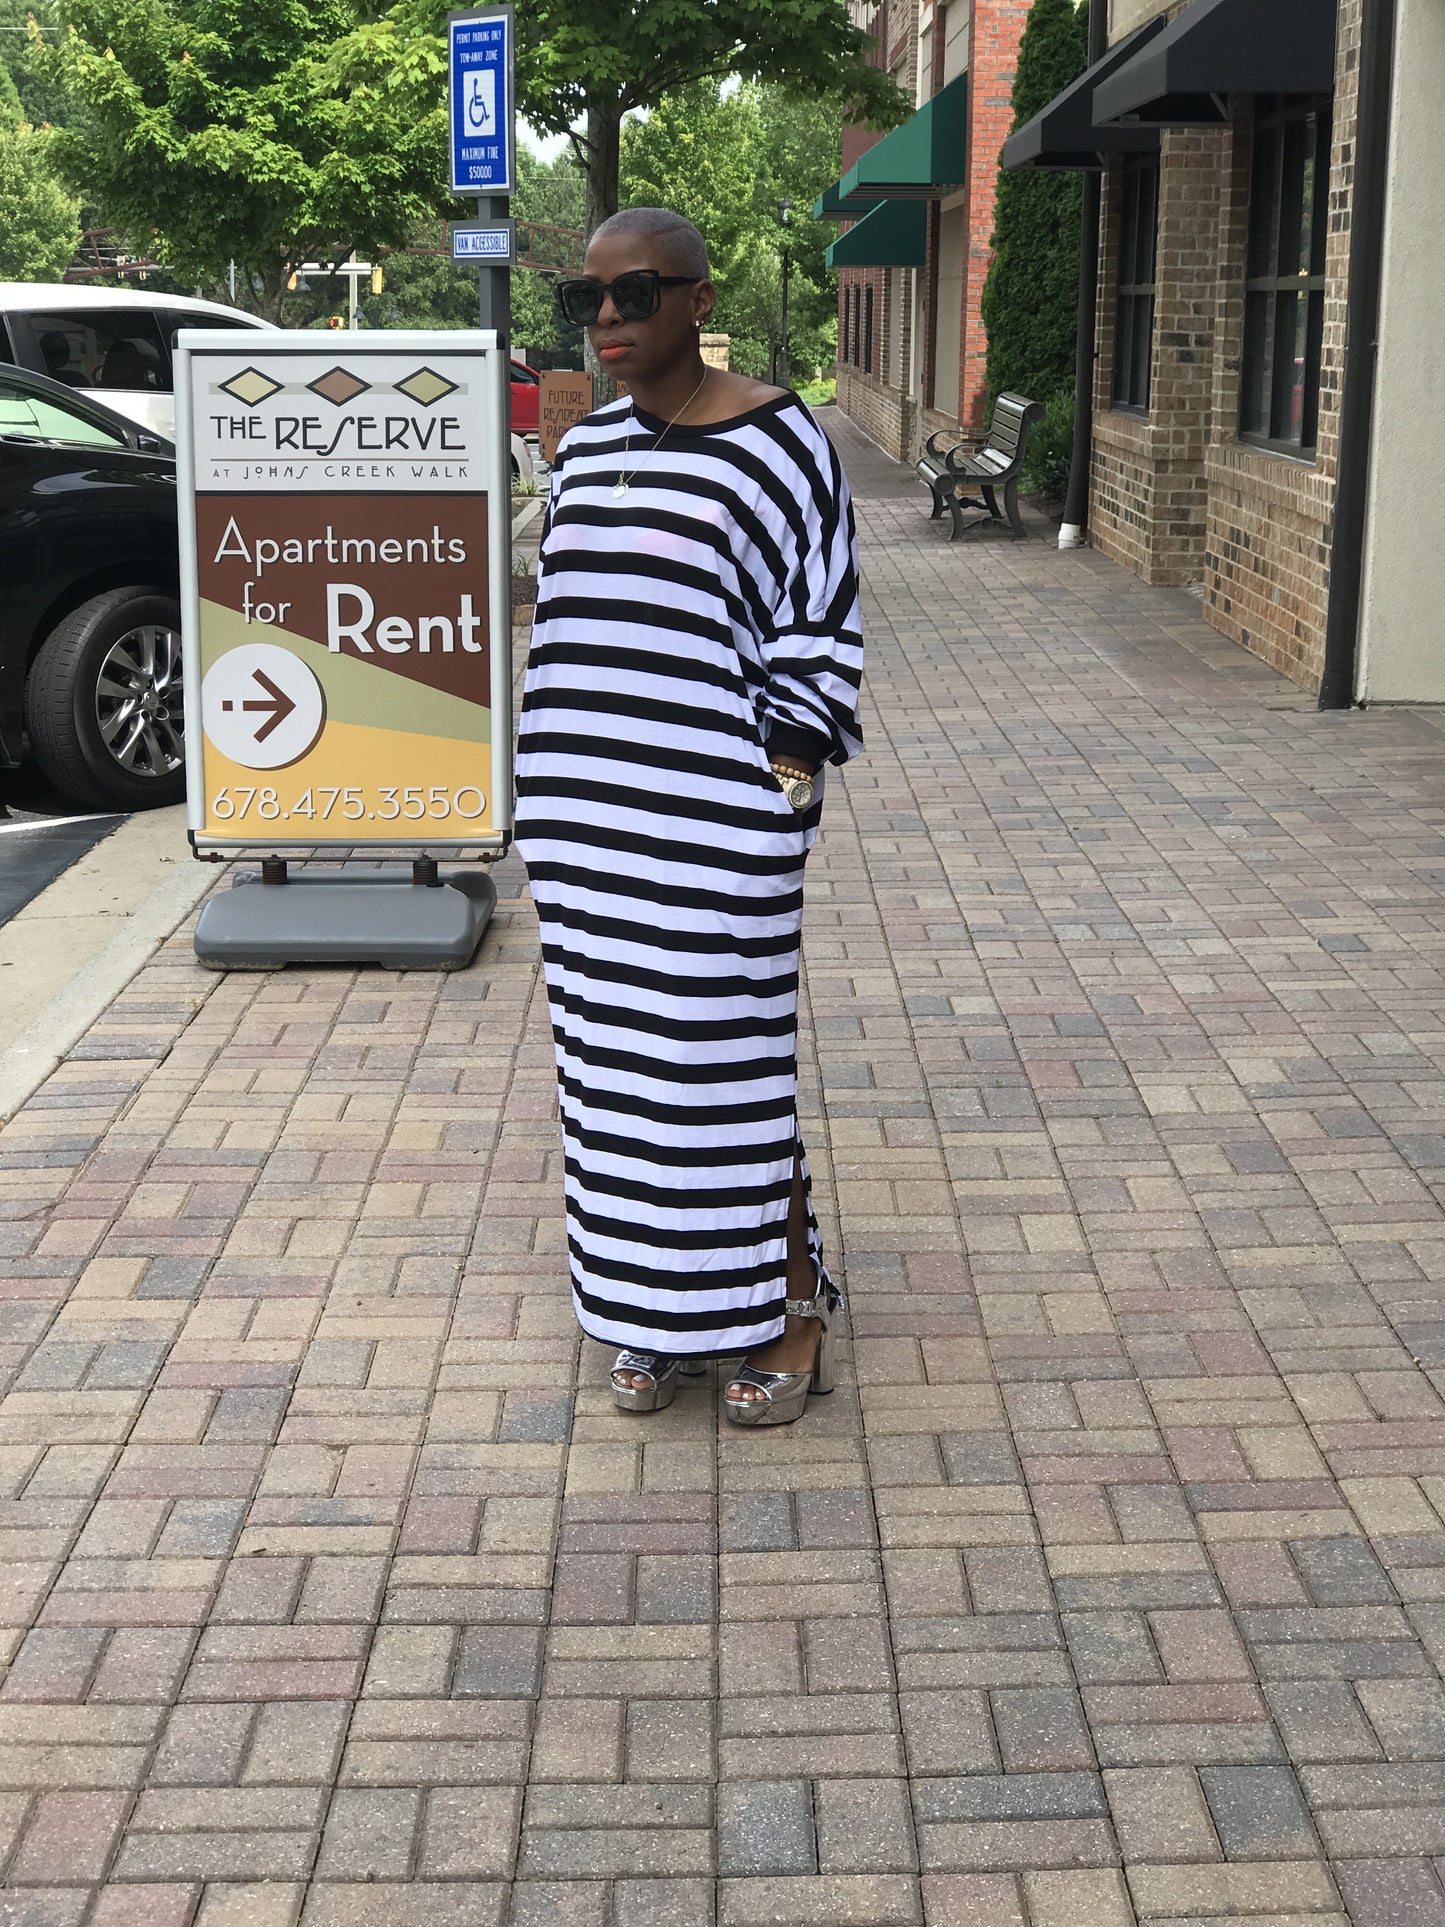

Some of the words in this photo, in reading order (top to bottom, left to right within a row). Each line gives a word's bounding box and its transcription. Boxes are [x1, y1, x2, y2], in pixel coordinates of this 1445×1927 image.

[456, 33, 471, 44] PERMIT
[472, 31, 489, 42] PARKING
[491, 30, 501, 40] ONLY
[460, 52, 483, 63] TOW-AWAY
[485, 50, 498, 61] ZONE
[461, 147, 485, 160] MAXIMUM
[487, 146, 499, 159] FINE
[457, 235, 469, 251] VAN
[472, 234, 506, 251] ACCESSIBLE
[548, 390, 584, 405] FUTURE
[210, 415, 267, 440] THE
[274, 415, 466, 456] RESERVE
[213, 468, 231, 478] AT
[243, 465, 309, 480] JOHNS
[324, 465, 395, 478] CREEK
[411, 465, 468, 478] WALK
[213, 515, 467, 577] Apartments
[242, 581, 292, 625] for
[326, 583, 483, 654] Rent
[211, 785, 487, 819] 678.475.3550
